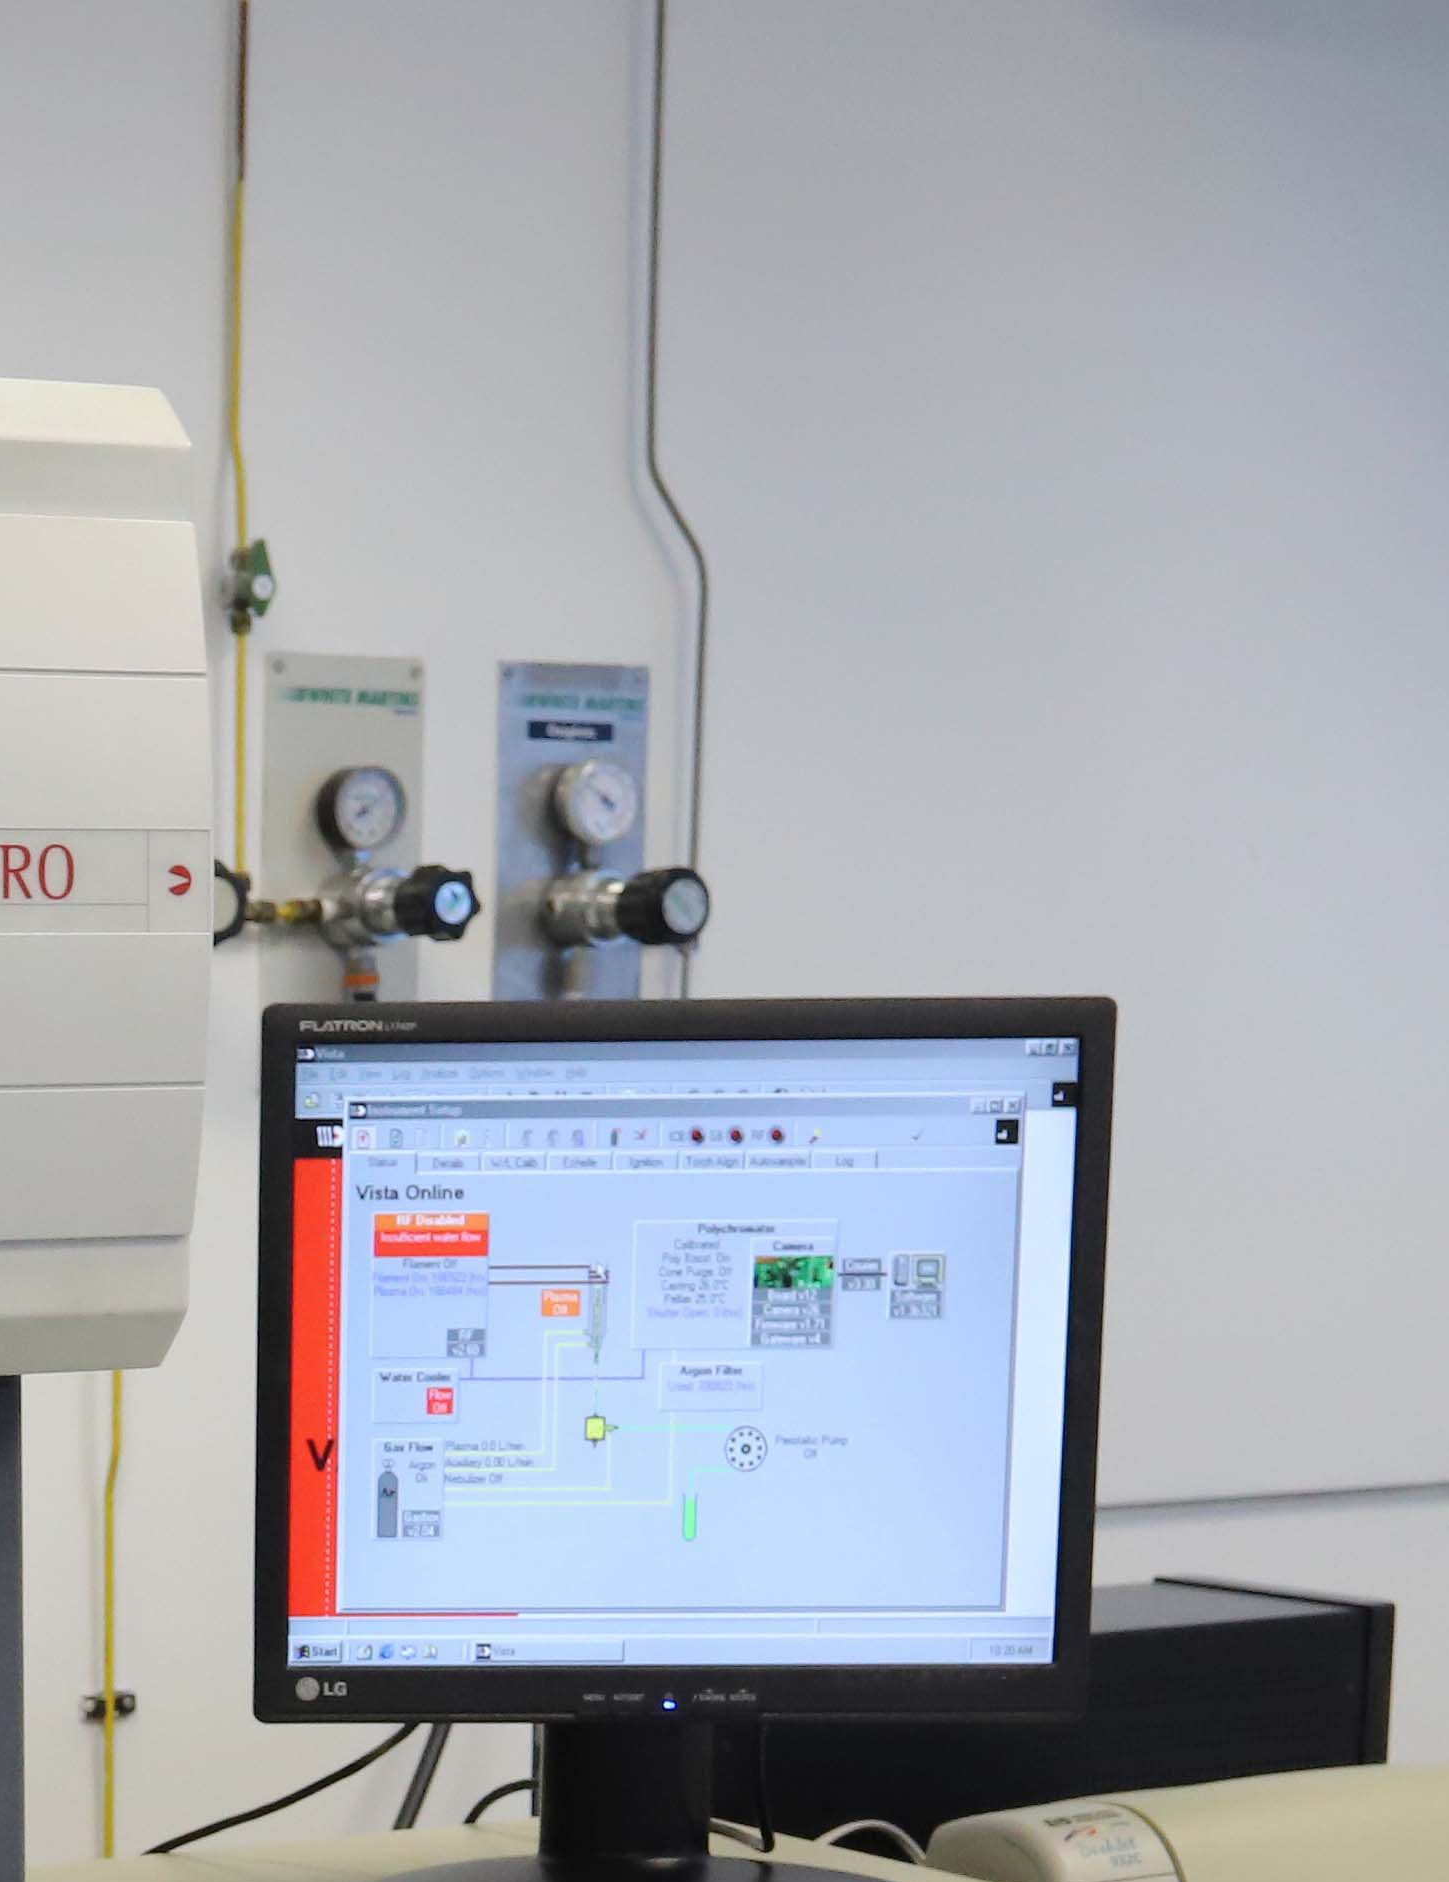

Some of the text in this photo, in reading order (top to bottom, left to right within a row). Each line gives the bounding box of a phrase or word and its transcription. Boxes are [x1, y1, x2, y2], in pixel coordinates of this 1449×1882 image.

[300, 1019, 383, 1032] FLATRON
[356, 1184, 465, 1200] Vista Online
[311, 1645, 339, 1657] Start
[323, 1680, 348, 1697] LG
